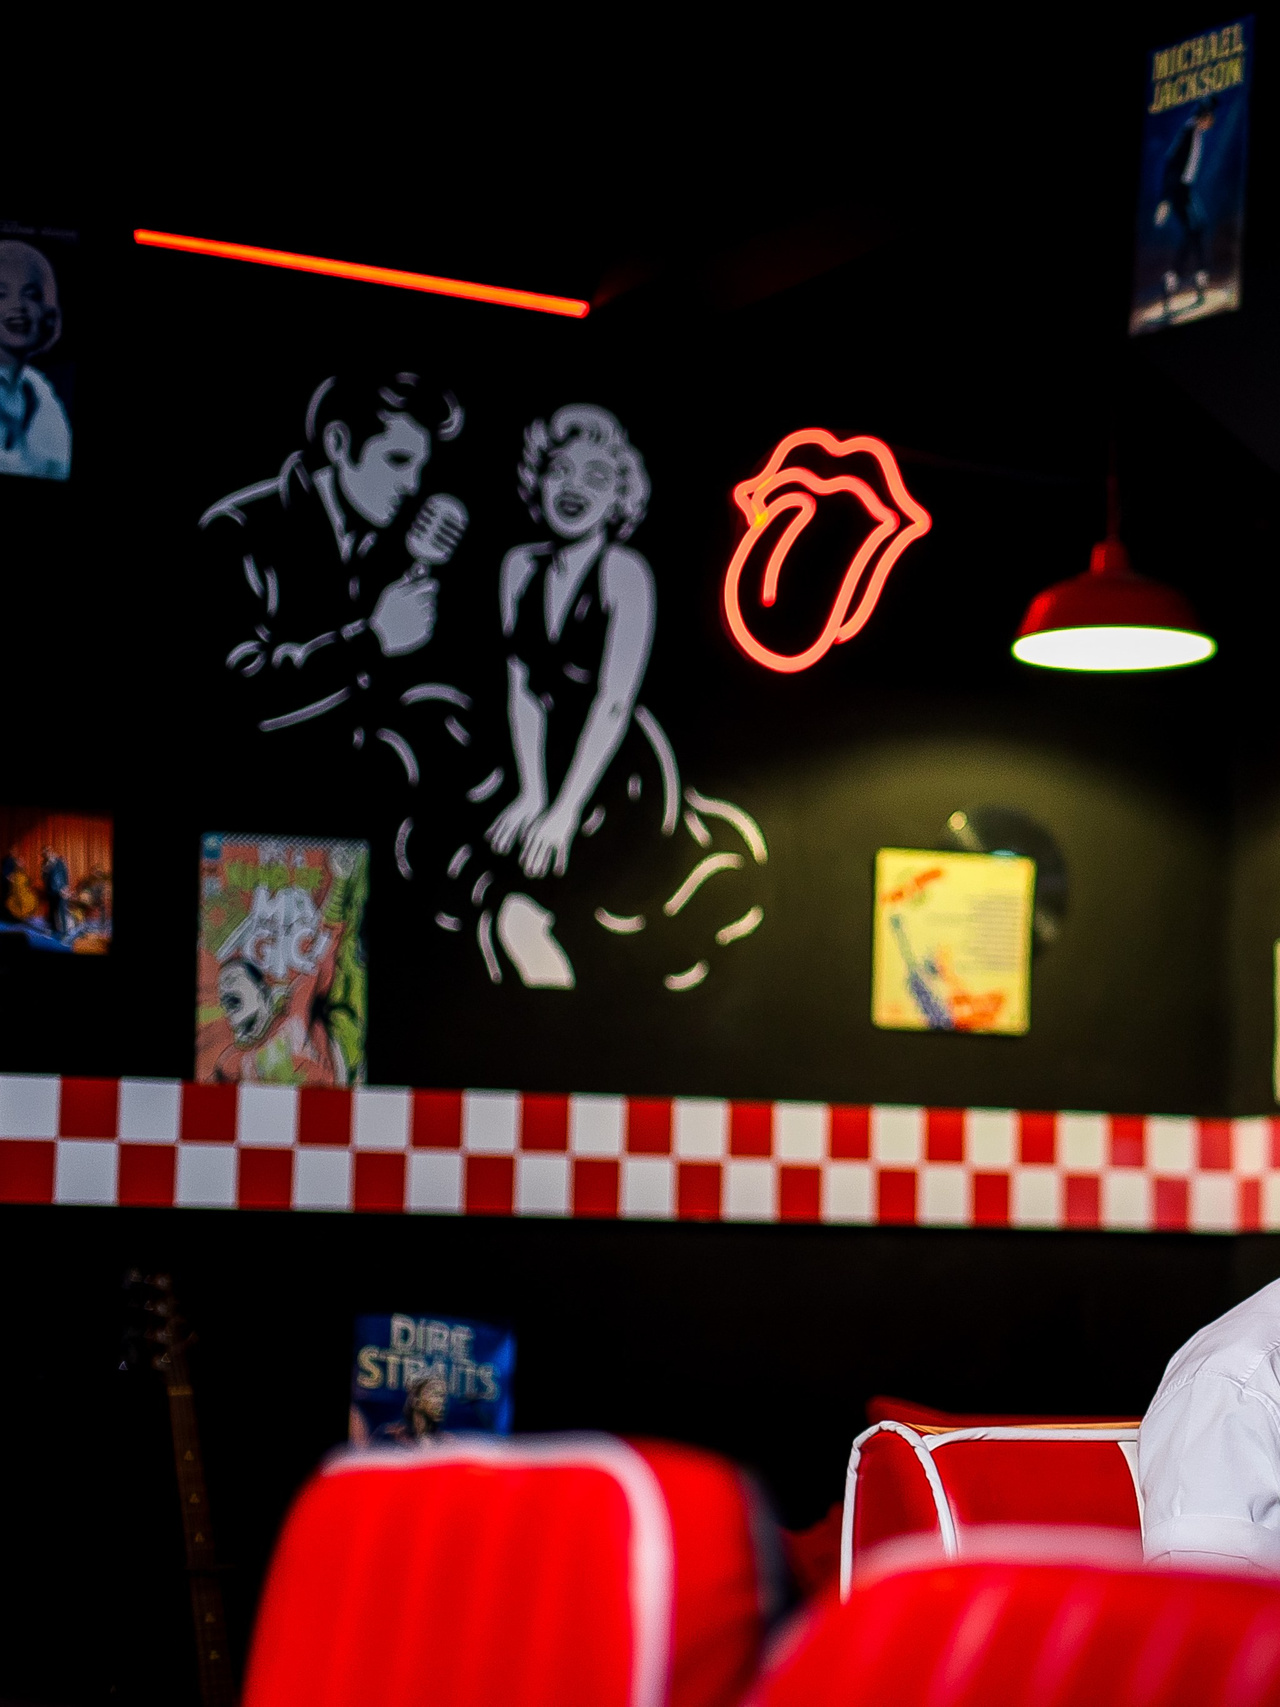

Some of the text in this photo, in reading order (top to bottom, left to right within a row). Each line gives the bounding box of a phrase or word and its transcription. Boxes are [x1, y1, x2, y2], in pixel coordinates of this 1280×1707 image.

[1153, 23, 1244, 81] MICHAEL
[1149, 56, 1243, 114] JACKSON
[391, 1313, 474, 1357] DIRE
[357, 1345, 498, 1400] STRAITS
